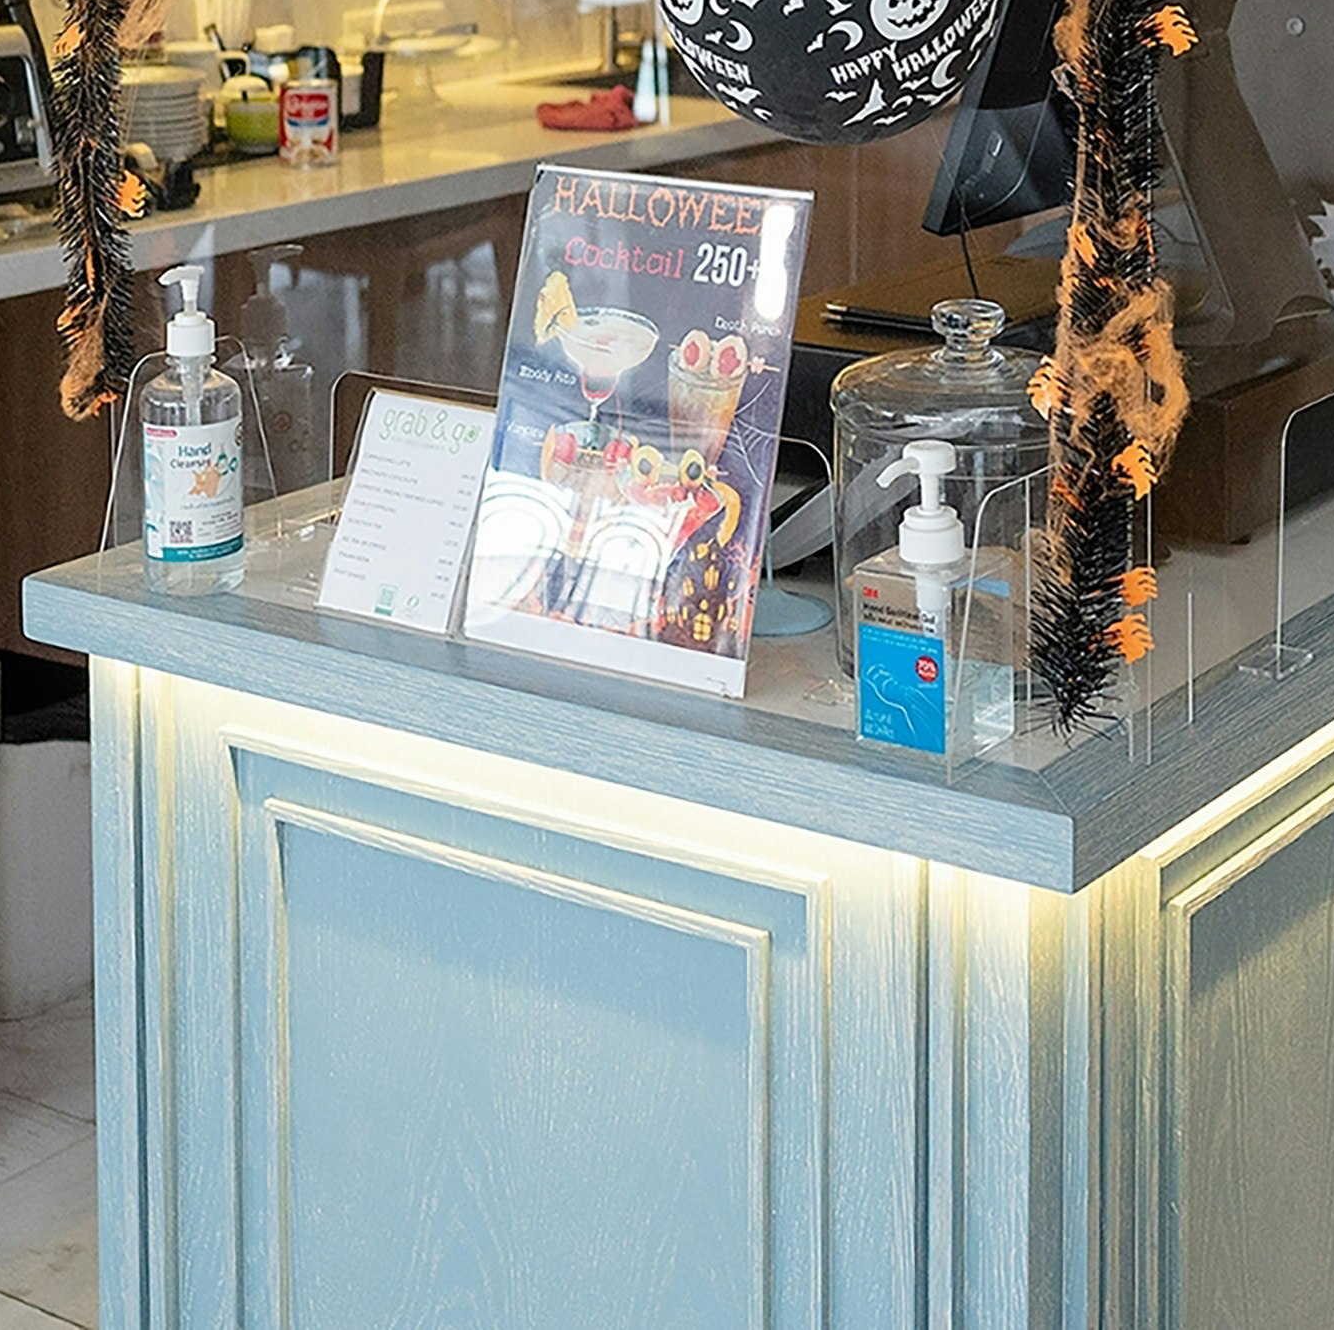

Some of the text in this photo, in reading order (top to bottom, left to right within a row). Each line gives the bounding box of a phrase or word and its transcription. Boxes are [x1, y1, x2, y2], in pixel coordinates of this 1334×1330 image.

[830, 41, 900, 85] HAPPY
[553, 175, 771, 238] HALLOWEE
[564, 236, 761, 288] Cocktail 250+
[379, 407, 428, 441] grab
[431, 409, 448, 441] &
[177, 441, 213, 458] Hand
